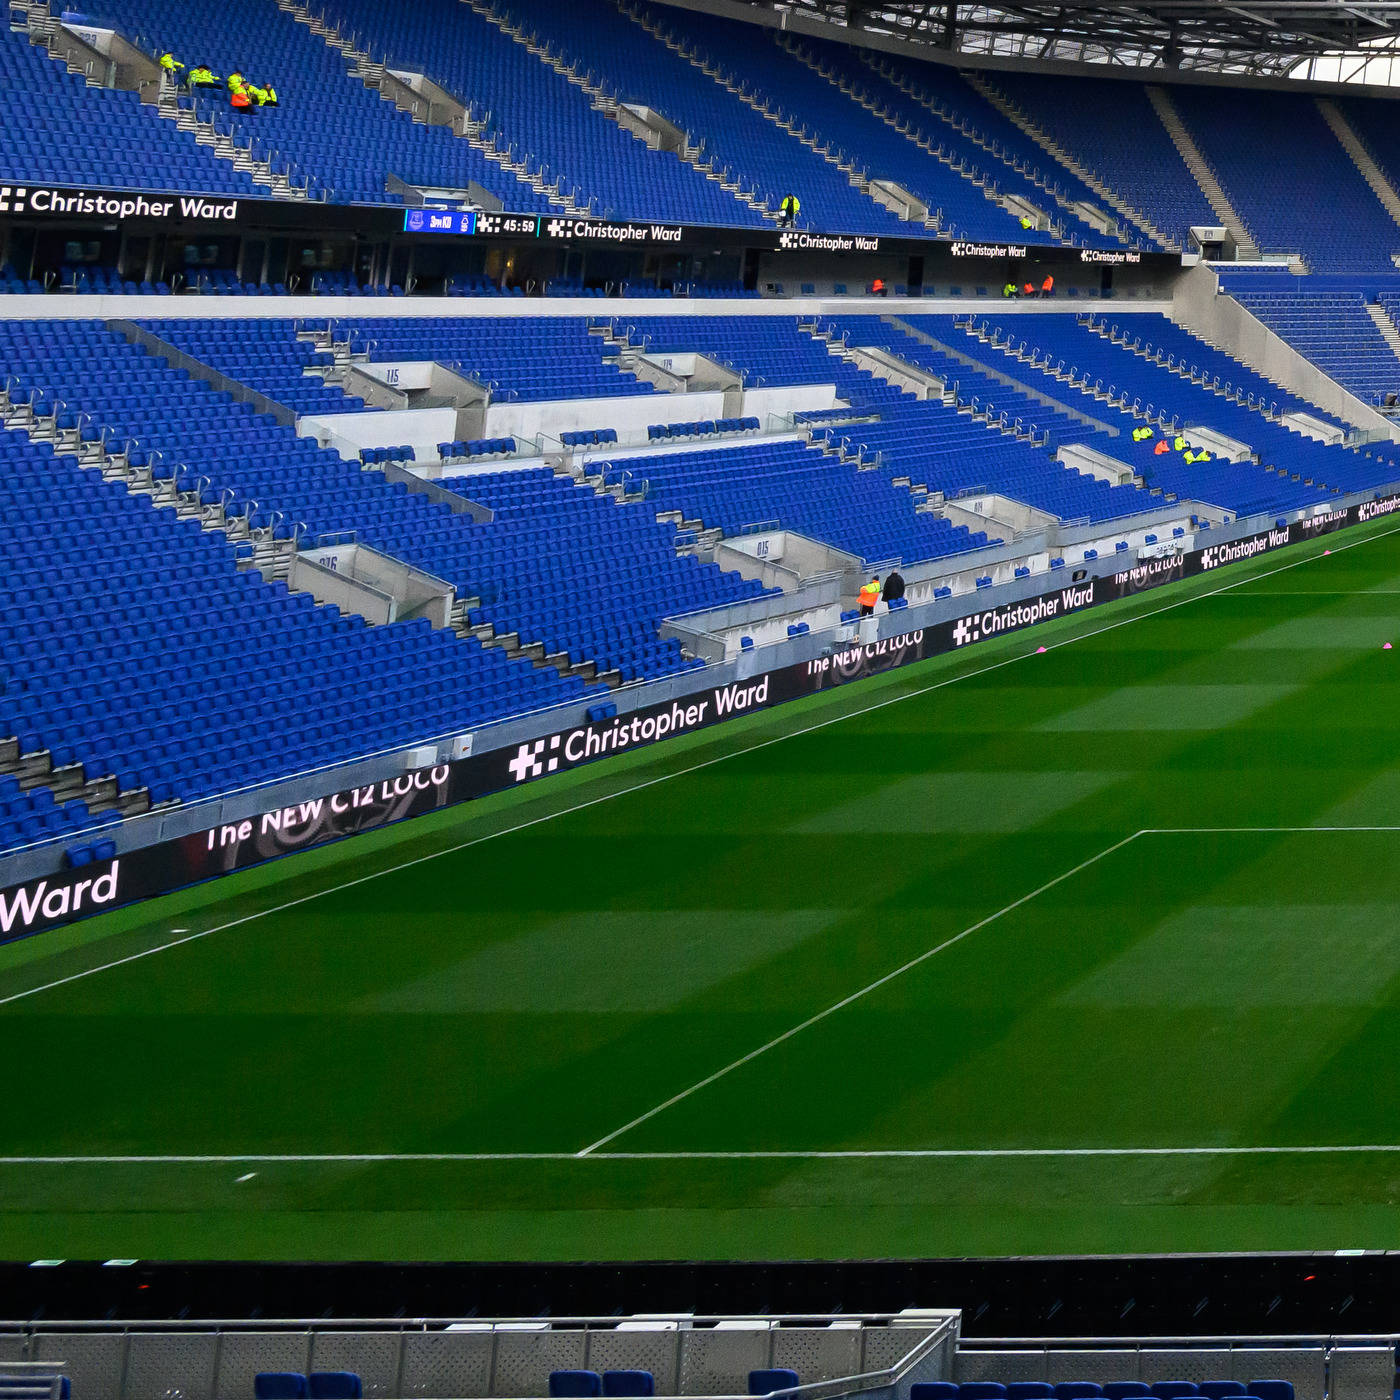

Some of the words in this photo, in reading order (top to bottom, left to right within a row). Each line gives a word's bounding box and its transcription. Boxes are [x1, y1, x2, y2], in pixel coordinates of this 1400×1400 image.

[30, 190, 174, 219] Christopher
[180, 198, 238, 220] Ward
[503, 219, 535, 232] 45:59
[574, 222, 649, 242] Christopher
[650, 225, 682, 242] Ward
[799, 234, 853, 252] Christopher
[854, 238, 879, 251] Ward
[965, 244, 1007, 258] Christopher
[1007, 245, 1027, 258] Ward
[386, 369, 400, 384] 115
[756, 541, 769, 557] 015
[1218, 538, 1268, 563] Christopher
[1268, 526, 1289, 548] Ward
[981, 597, 1060, 635] Christopher
[1062, 582, 1094, 610] Ward
[832, 646, 863, 669] NEW
[889, 629, 924, 652] LOCO
[564, 702, 709, 762] Christopher
[714, 675, 769, 717] Ward
[207, 820, 253, 851] The
[261, 798, 324, 835] NEW
[330, 784, 375, 814] C12
[381, 764, 450, 800] LOCO
[0, 859, 119, 933] Ward
